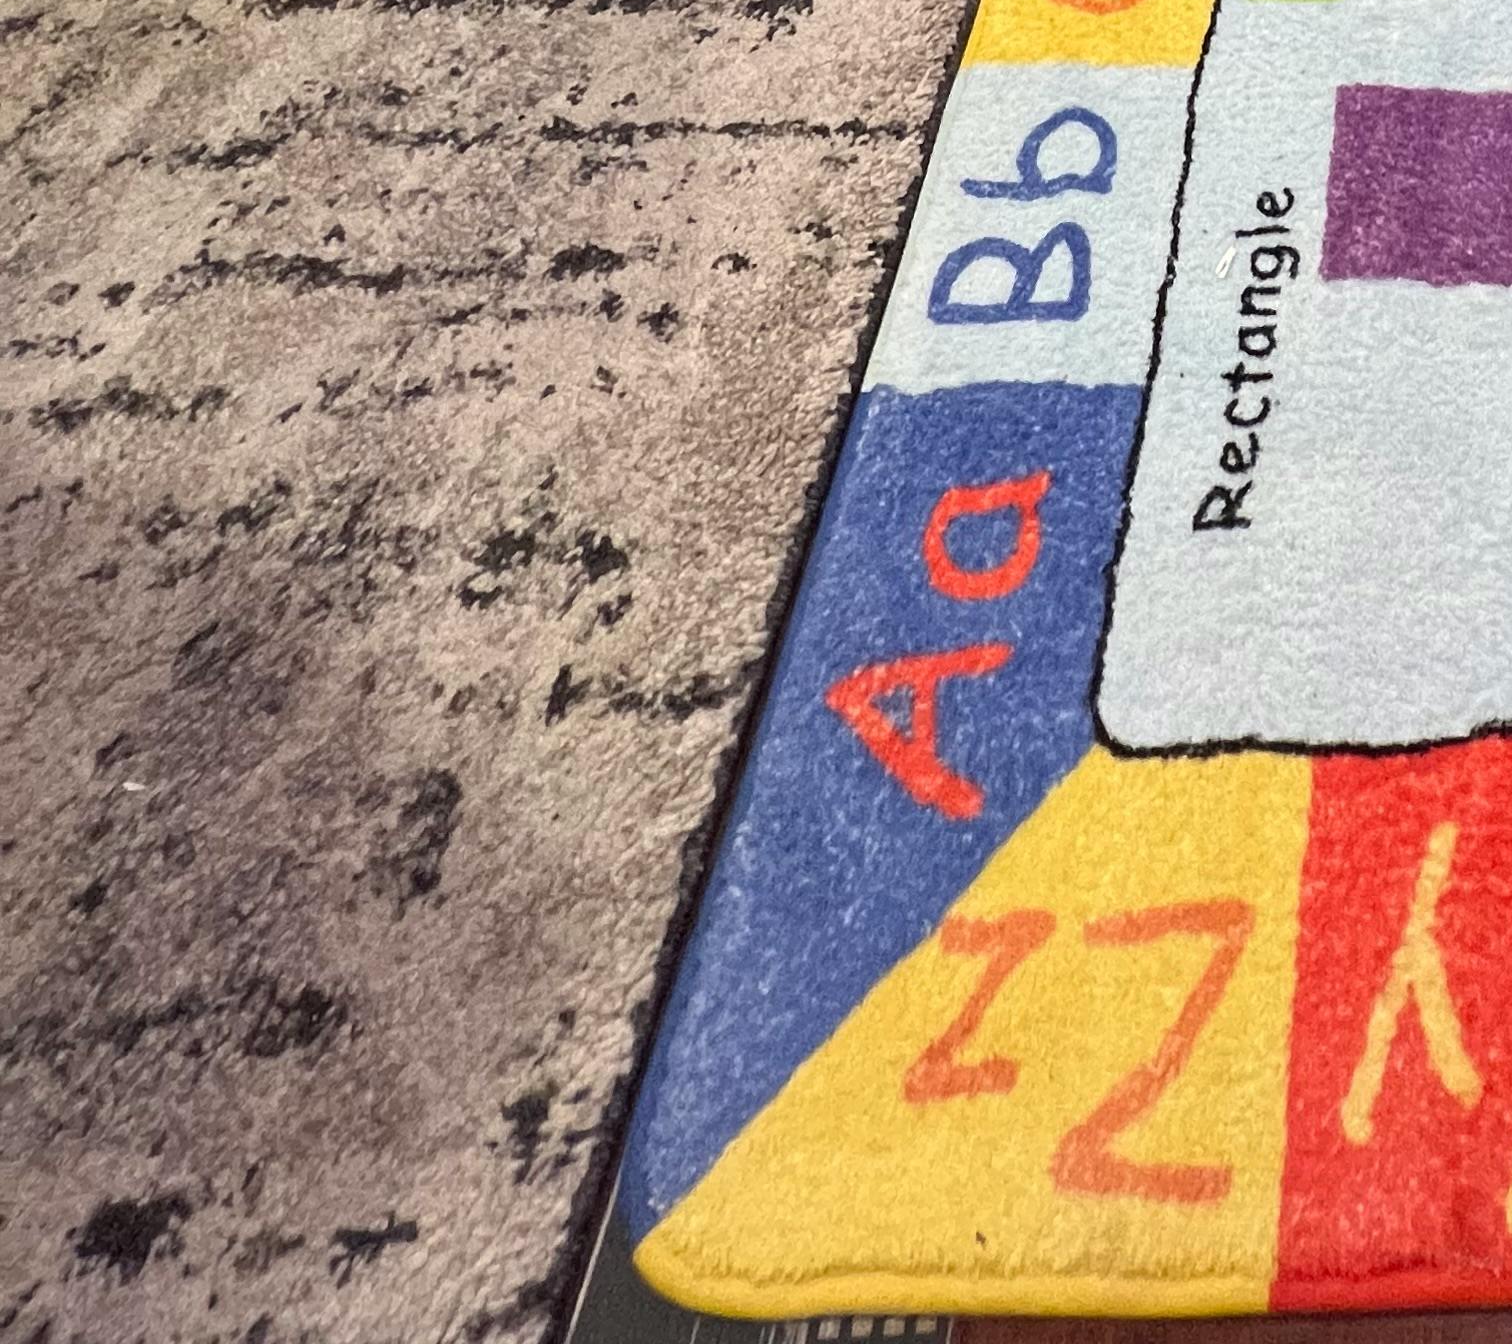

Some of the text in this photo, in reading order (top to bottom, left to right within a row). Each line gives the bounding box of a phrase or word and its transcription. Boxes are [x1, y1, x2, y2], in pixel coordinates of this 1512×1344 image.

[927, 106, 1119, 324] Bb
[1191, 184, 1302, 534] Rectangle
[823, 469, 1054, 823] Aa
